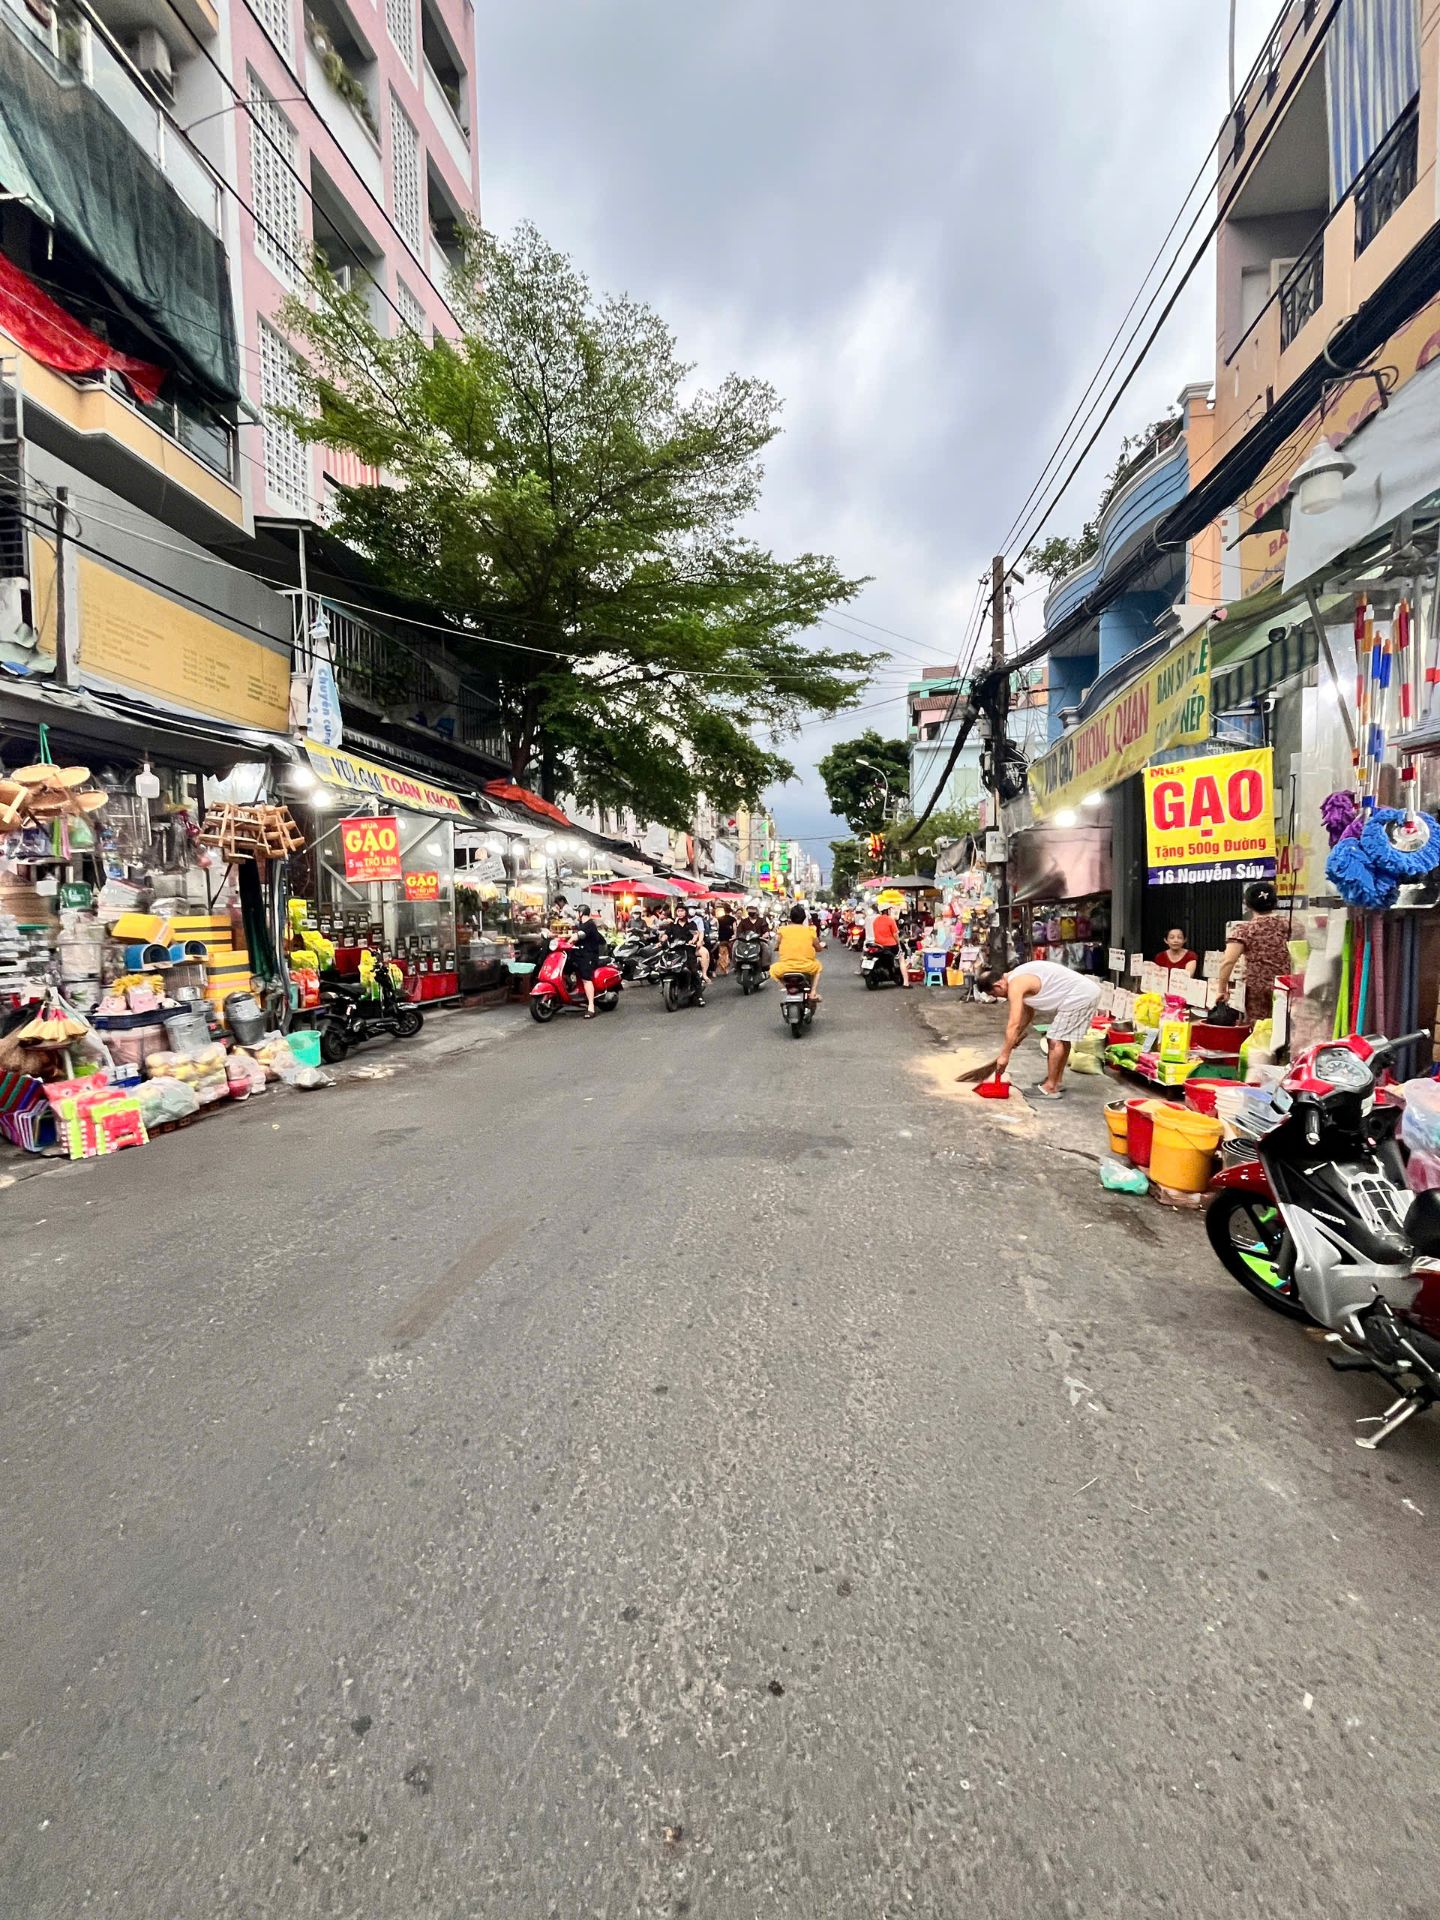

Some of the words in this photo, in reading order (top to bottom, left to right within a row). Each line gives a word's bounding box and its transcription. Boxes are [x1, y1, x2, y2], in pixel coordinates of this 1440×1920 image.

[1153, 769, 1264, 838] GẠO
[345, 828, 397, 857] GẠO
[1155, 844, 1185, 861] Tặng
[1188, 841, 1220, 856] 500g
[1224, 836, 1267, 853] Đường
[406, 876, 437, 888] GẠO
[1158, 870, 1175, 885] 16
[1177, 862, 1232, 884] Nguyễn
[1235, 863, 1265, 880] Súy
[1311, 1208, 1347, 1226] HONDA
